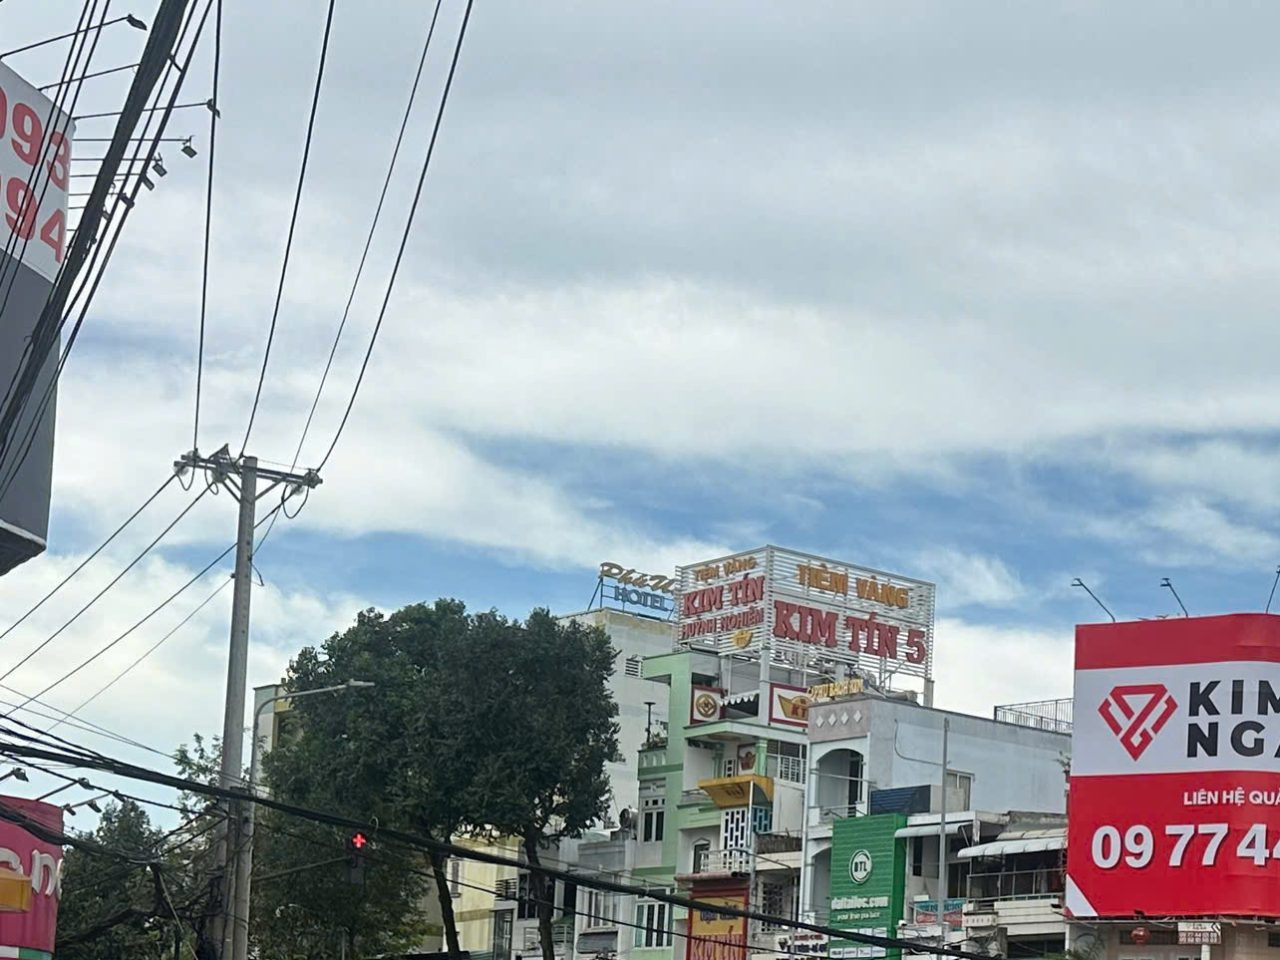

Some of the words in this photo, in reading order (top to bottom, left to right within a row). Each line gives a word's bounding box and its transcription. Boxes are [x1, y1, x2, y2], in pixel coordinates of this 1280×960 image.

[0, 86, 69, 192] 93
[0, 176, 65, 264] 94
[614, 586, 668, 611] HOTEL
[682, 585, 724, 617] KIM
[728, 573, 766, 607] TÍN
[855, 575, 909, 609] VÀNG
[773, 600, 839, 648] KIM
[845, 611, 900, 660] TÍN
[906, 629, 926, 664] 5
[1183, 789, 1219, 806] LIÊN
[1222, 787, 1245, 807] HỆ
[1092, 825, 1154, 869] 09
[1165, 823, 1229, 867] 77
